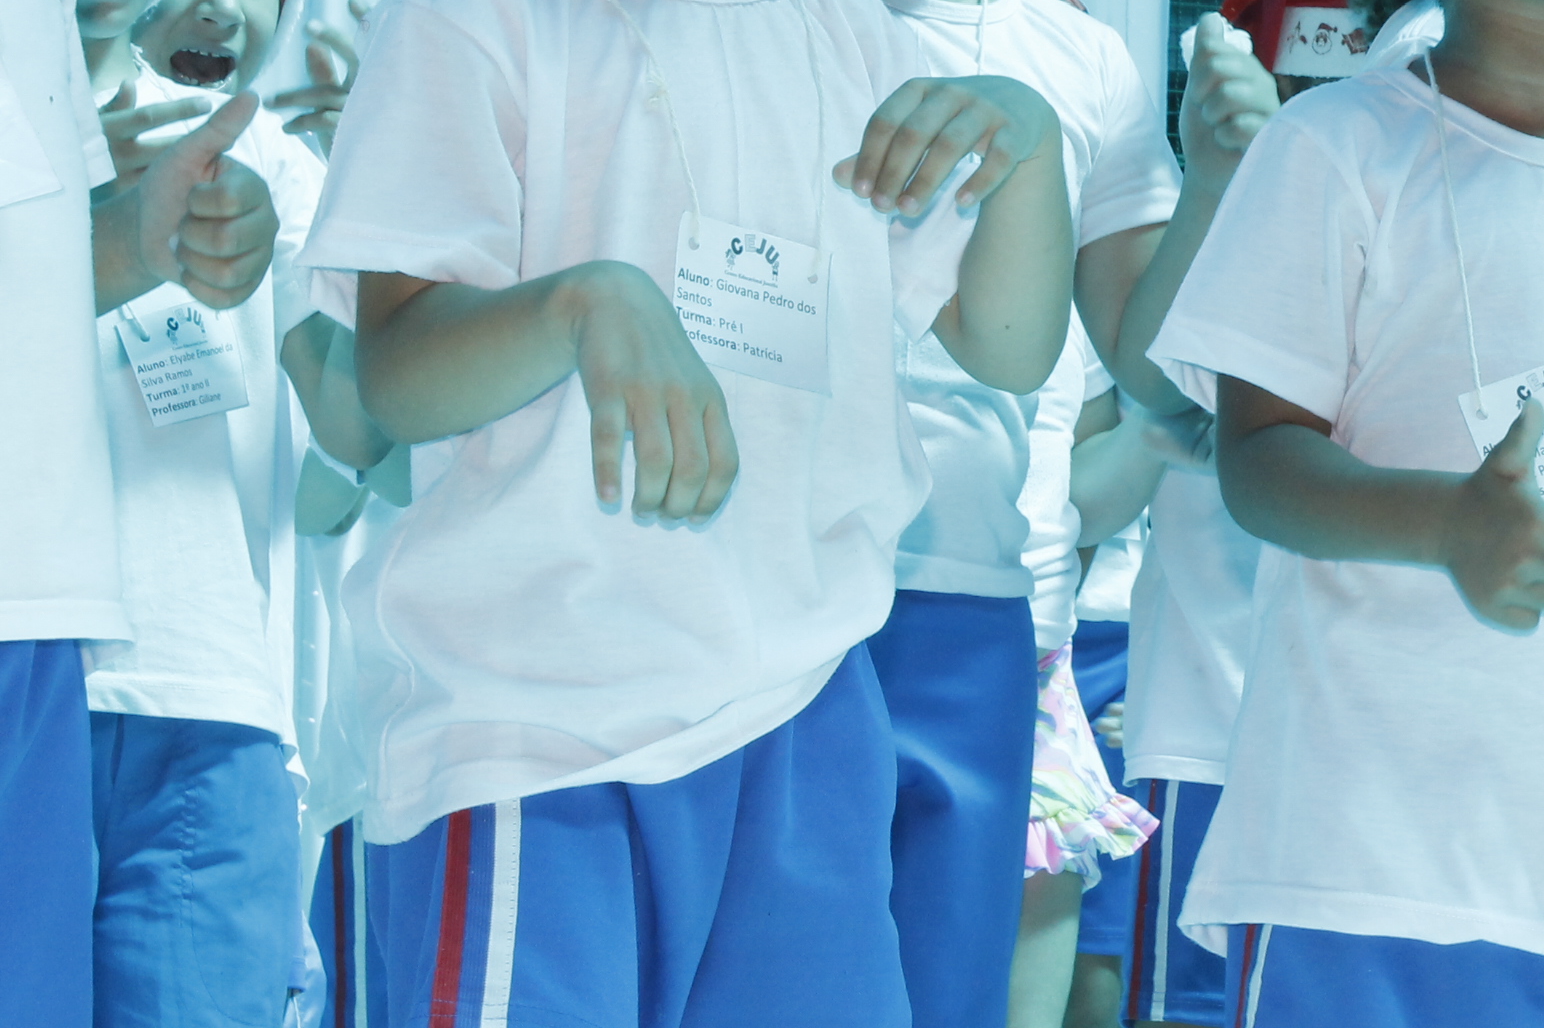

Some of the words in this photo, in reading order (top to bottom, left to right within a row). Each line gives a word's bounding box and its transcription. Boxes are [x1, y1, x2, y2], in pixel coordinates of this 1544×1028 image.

[731, 233, 780, 265] CEJU
[676, 286, 712, 307] Santos
[677, 268, 714, 288] Aluno:
[716, 278, 760, 301] Giovana
[762, 290, 794, 310] Pedro
[797, 300, 817, 316] dos
[675, 306, 716, 327] Turma:
[719, 317, 737, 333] Pré
[743, 342, 783, 363] Patrícia
[137, 359, 168, 375] Aluno:
[141, 374, 164, 389] Silva
[165, 368, 193, 382] Ramos
[145, 387, 181, 403] Turma:
[191, 380, 204, 391] ano
[152, 398, 198, 417] Professora:
